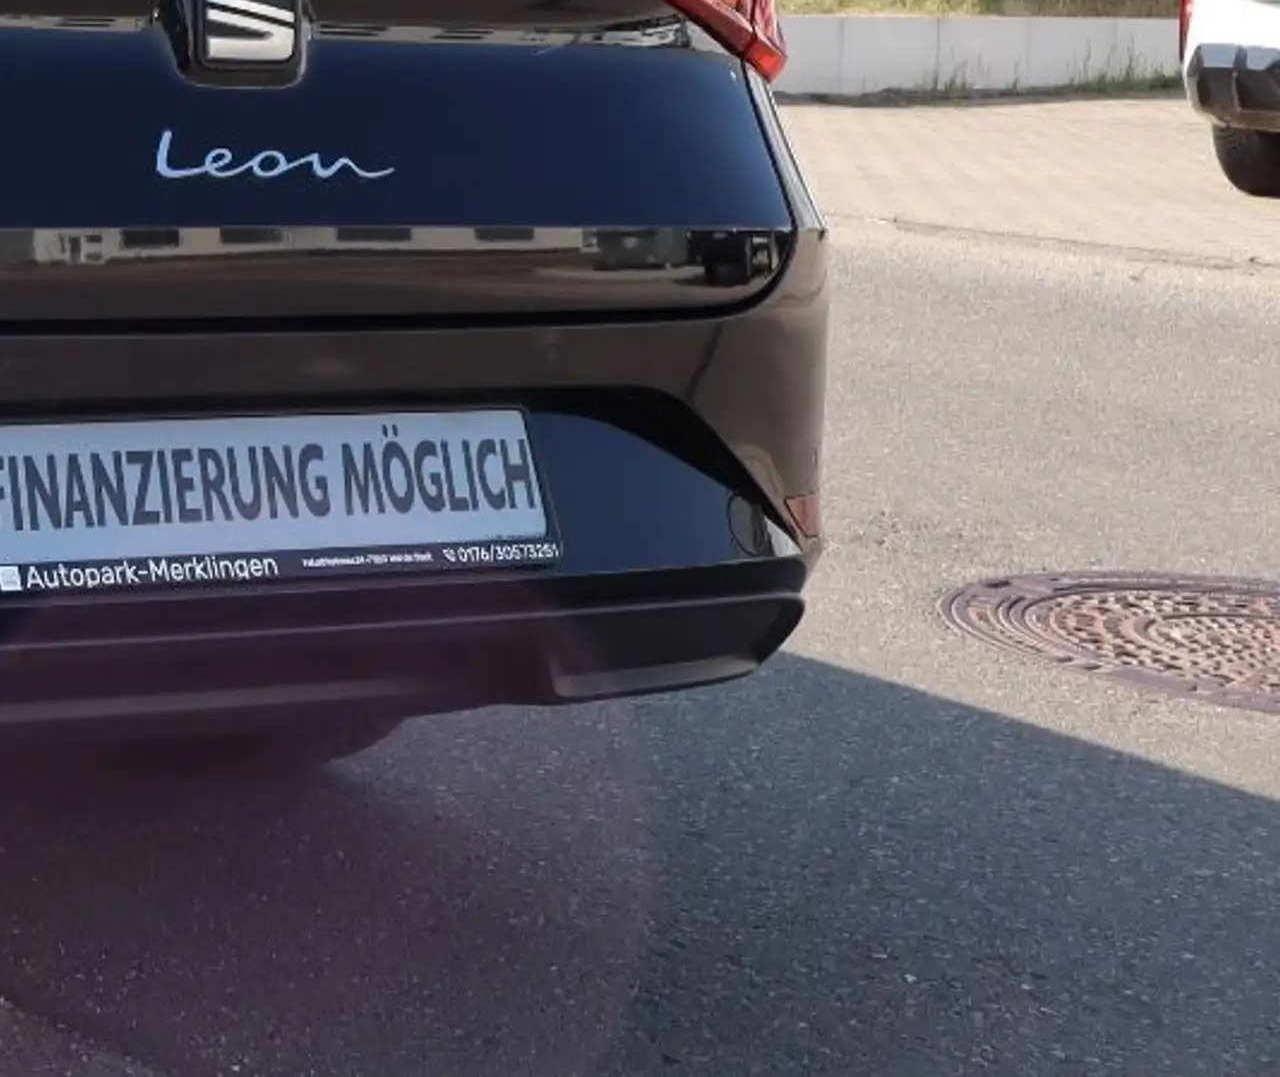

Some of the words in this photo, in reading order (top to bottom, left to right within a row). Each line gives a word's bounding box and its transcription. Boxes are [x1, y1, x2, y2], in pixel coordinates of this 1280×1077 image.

[155, 129, 396, 178] Leon
[340, 423, 537, 516] MÖGLICH
[26, 554, 279, 590] Autopark-Merklingen
